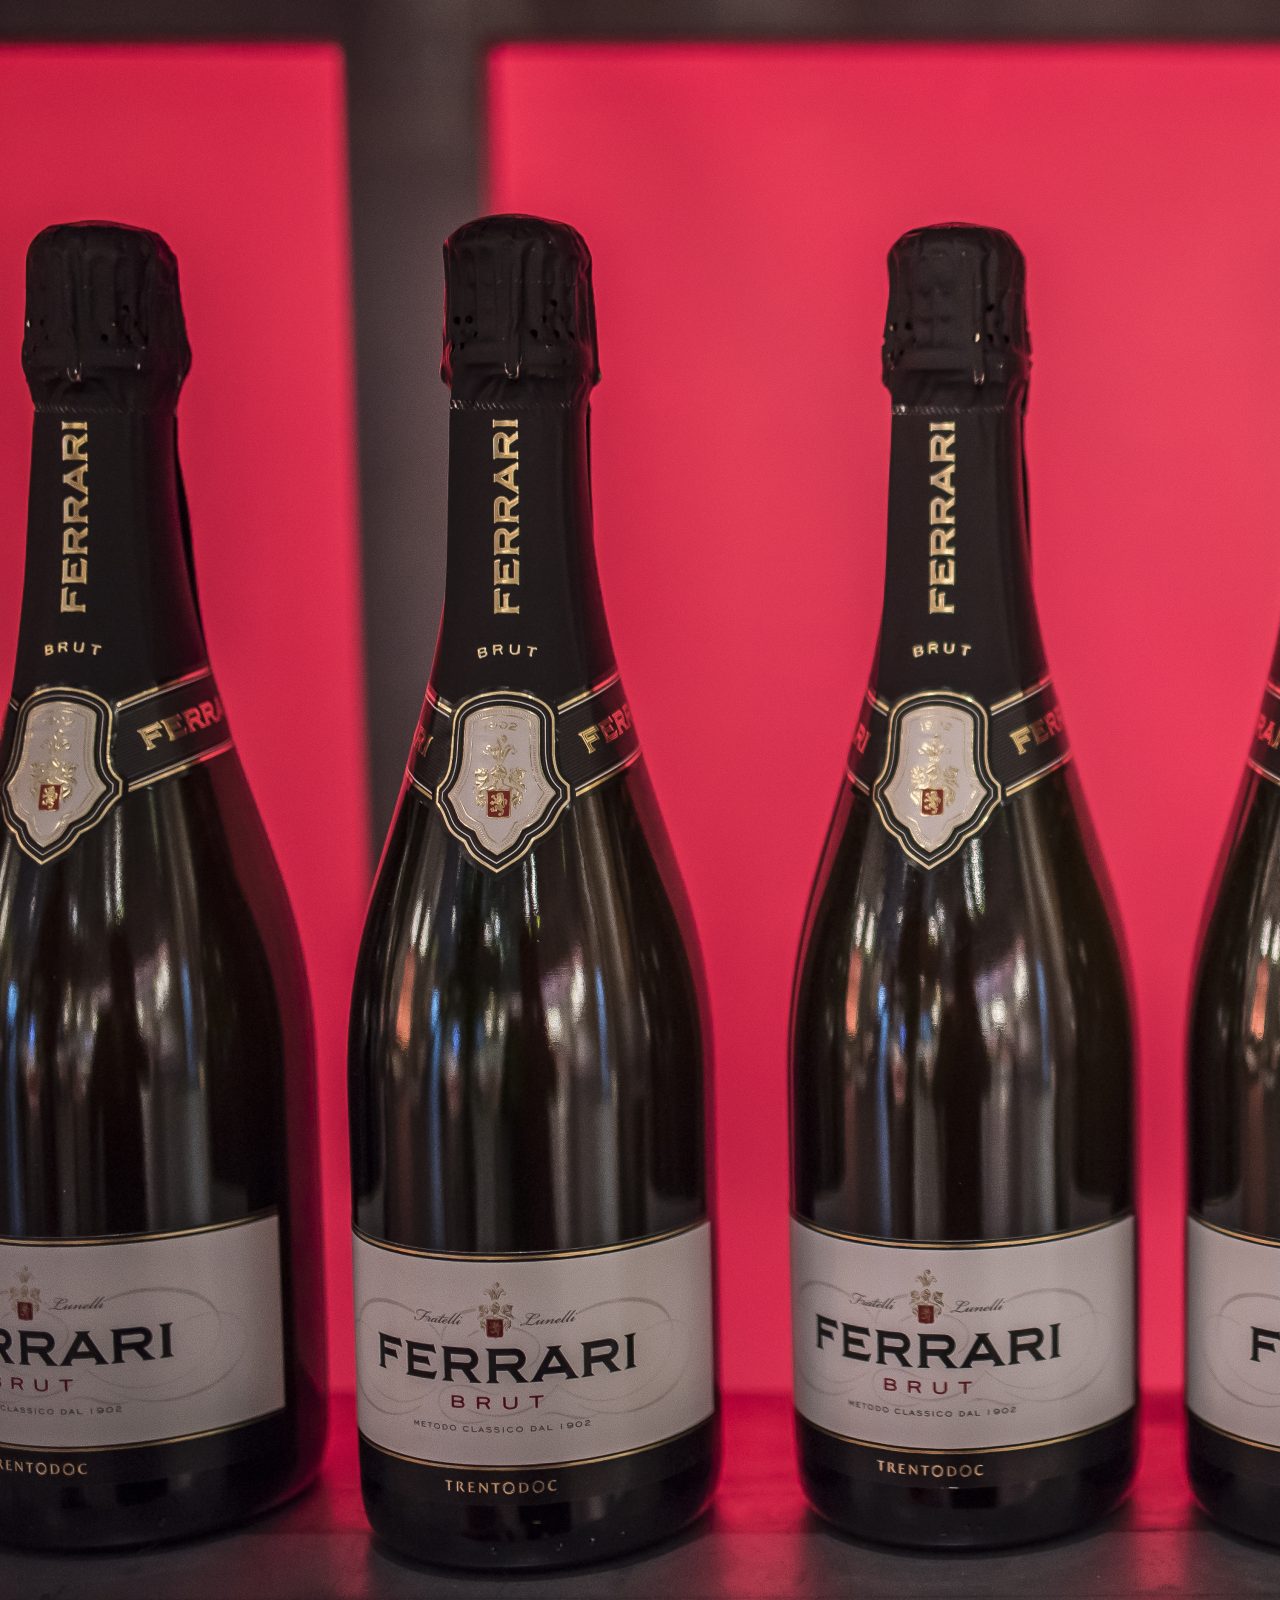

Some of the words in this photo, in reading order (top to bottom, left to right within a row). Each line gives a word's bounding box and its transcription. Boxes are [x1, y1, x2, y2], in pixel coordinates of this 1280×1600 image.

[61, 421, 88, 613] FERRARI
[493, 419, 520, 614] FERRARI
[929, 421, 955, 614] FERRARI
[45, 642, 102, 656] BRUT
[477, 644, 537, 659] BRUT
[913, 642, 971, 657] BRUT
[850, 1292, 896, 1310] Fratelli
[950, 1298, 1006, 1313] Lunelli
[413, 1308, 464, 1326] Fratelli
[520, 1309, 578, 1327] Lunelli
[816, 1314, 1061, 1369] FERRARI
[378, 1331, 637, 1383] FERRARI
[0, 1377, 73, 1392] RUT
[883, 1377, 973, 1395] BRUT
[90, 1406, 122, 1415] 1902
[452, 1395, 544, 1410] BRUT
[848, 1400, 890, 1414] METODO
[895, 1408, 953, 1418] CLASSICO
[959, 1409, 981, 1417] DAL
[987, 1406, 1017, 1415] 1902
[414, 1419, 457, 1431] METODO
[463, 1425, 524, 1433] CLASSICO
[531, 1423, 553, 1432] DAL
[560, 1419, 591, 1429] 1902
[877, 1460, 984, 1478] TRENTODOC
[445, 1479, 557, 1495] TRENTODOC
